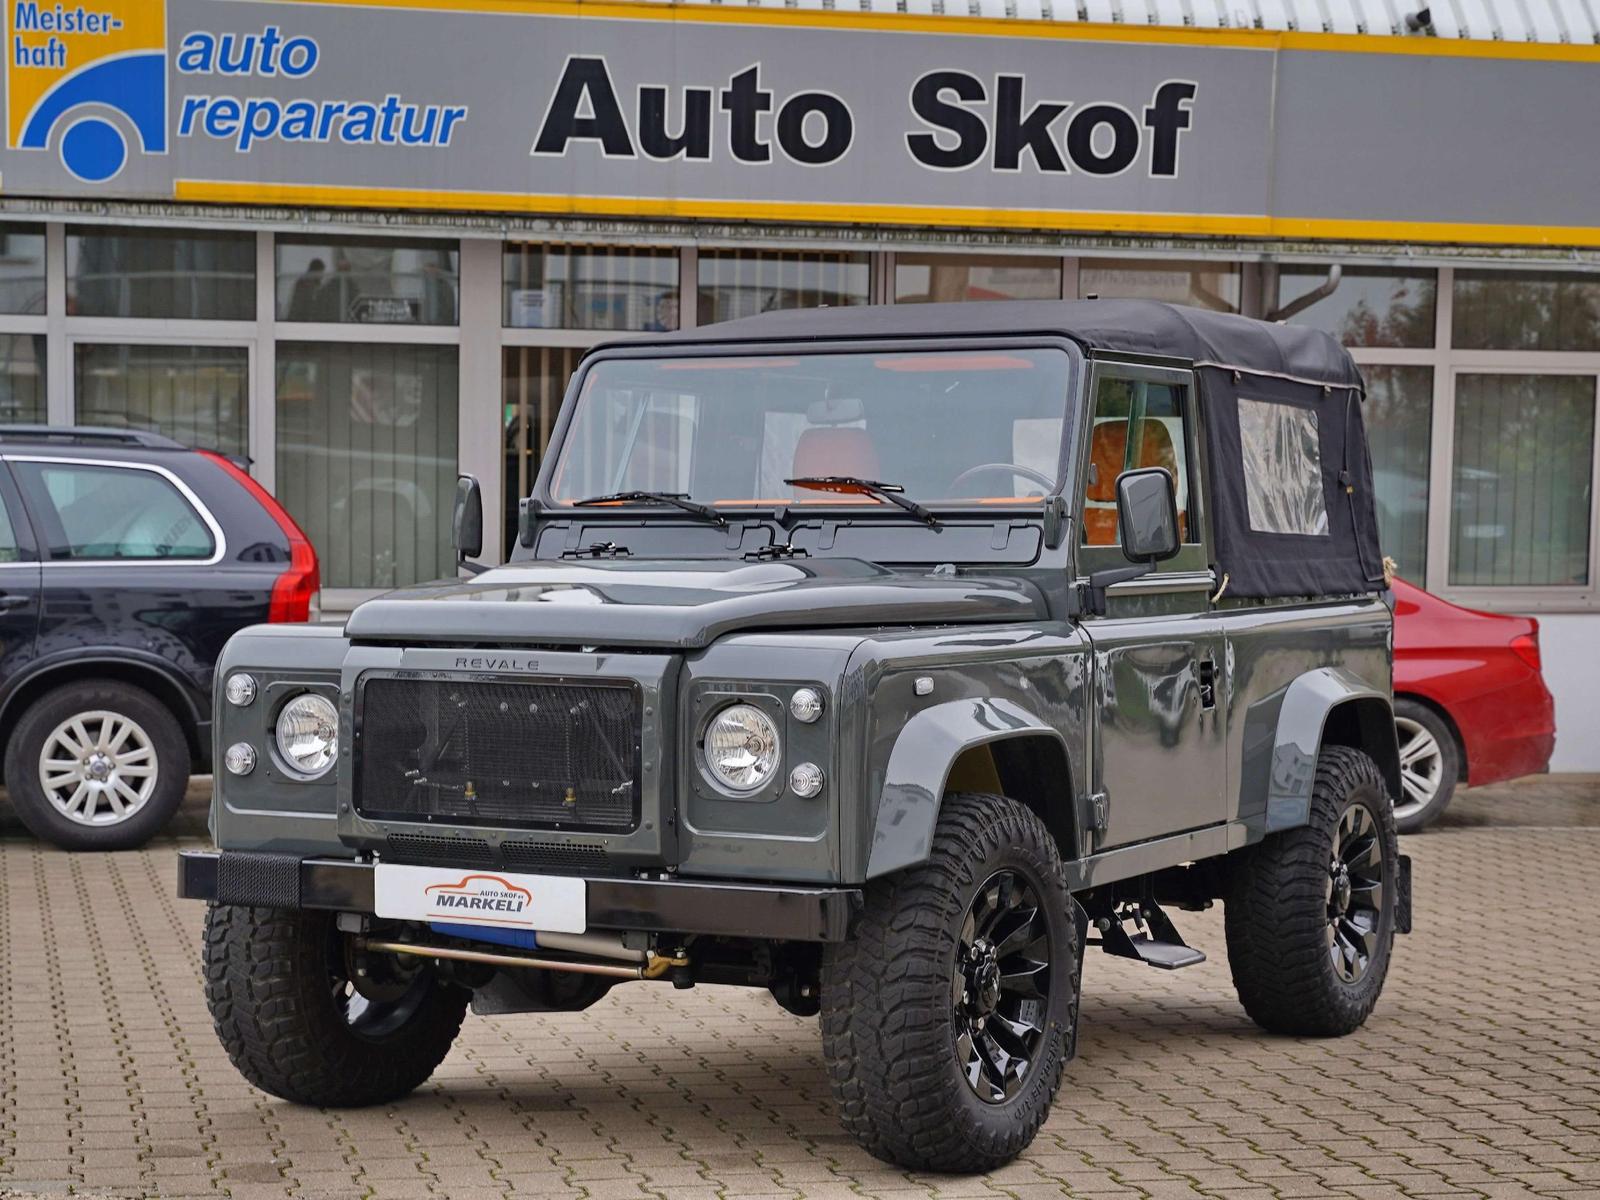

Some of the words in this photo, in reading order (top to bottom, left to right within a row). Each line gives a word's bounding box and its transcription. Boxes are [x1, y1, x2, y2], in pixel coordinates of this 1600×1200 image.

[14, 1, 123, 33] Meister-
[14, 37, 67, 68] haft
[178, 25, 319, 78] auto
[178, 93, 468, 152] reparatur
[530, 54, 855, 167] Auto
[905, 68, 1198, 179] Skof
[455, 657, 539, 671] REVALE
[436, 895, 523, 912] MARKELI
